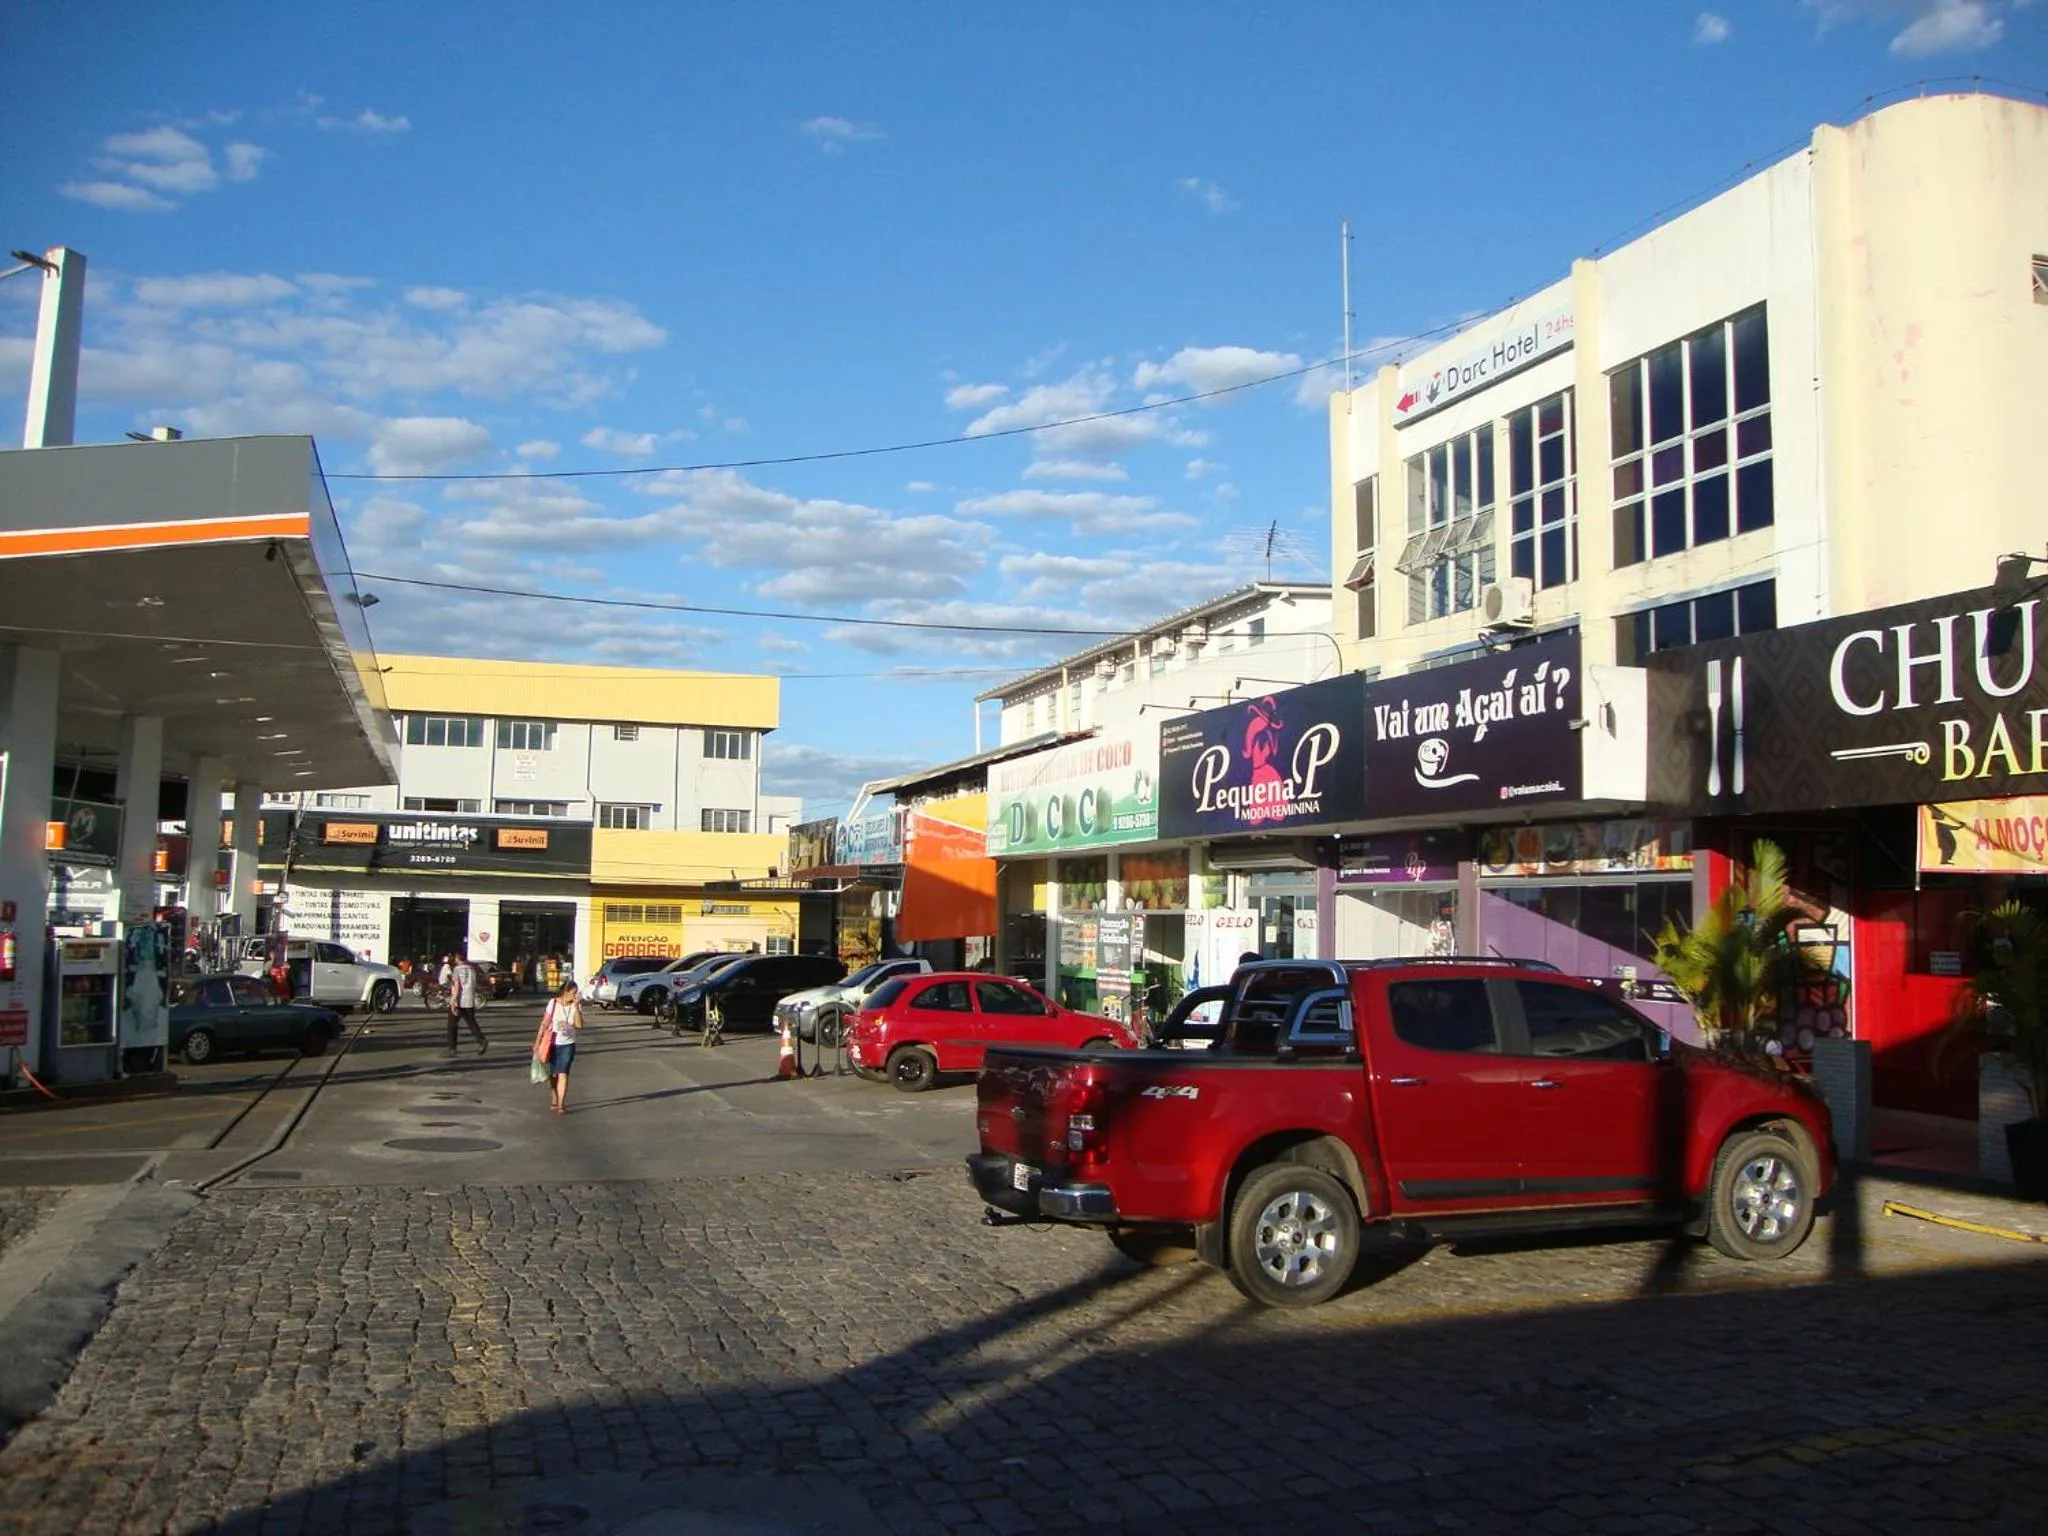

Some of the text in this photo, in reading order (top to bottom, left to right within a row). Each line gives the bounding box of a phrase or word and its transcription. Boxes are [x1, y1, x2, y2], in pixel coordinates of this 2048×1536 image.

[1493, 324, 1538, 369] Hotel
[1830, 600, 2041, 716] CHU
[1374, 699, 1410, 741] Vai
[1455, 668, 1518, 743] Açaí
[1097, 740, 1132, 772] COCO
[1192, 744, 1294, 819] Pequena
[1010, 801, 1025, 845] D
[1047, 794, 1061, 840] C
[1079, 788, 1094, 835] C
[1240, 800, 1320, 821] MODA FEMININA
[342, 829, 375, 839] Suvinil
[388, 822, 478, 842] unitintas
[513, 835, 545, 845] Suvinil
[1973, 815, 2048, 861] ALMOÇ
[1215, 916, 1253, 929] GELO
[605, 943, 681, 958] GARAGEM
